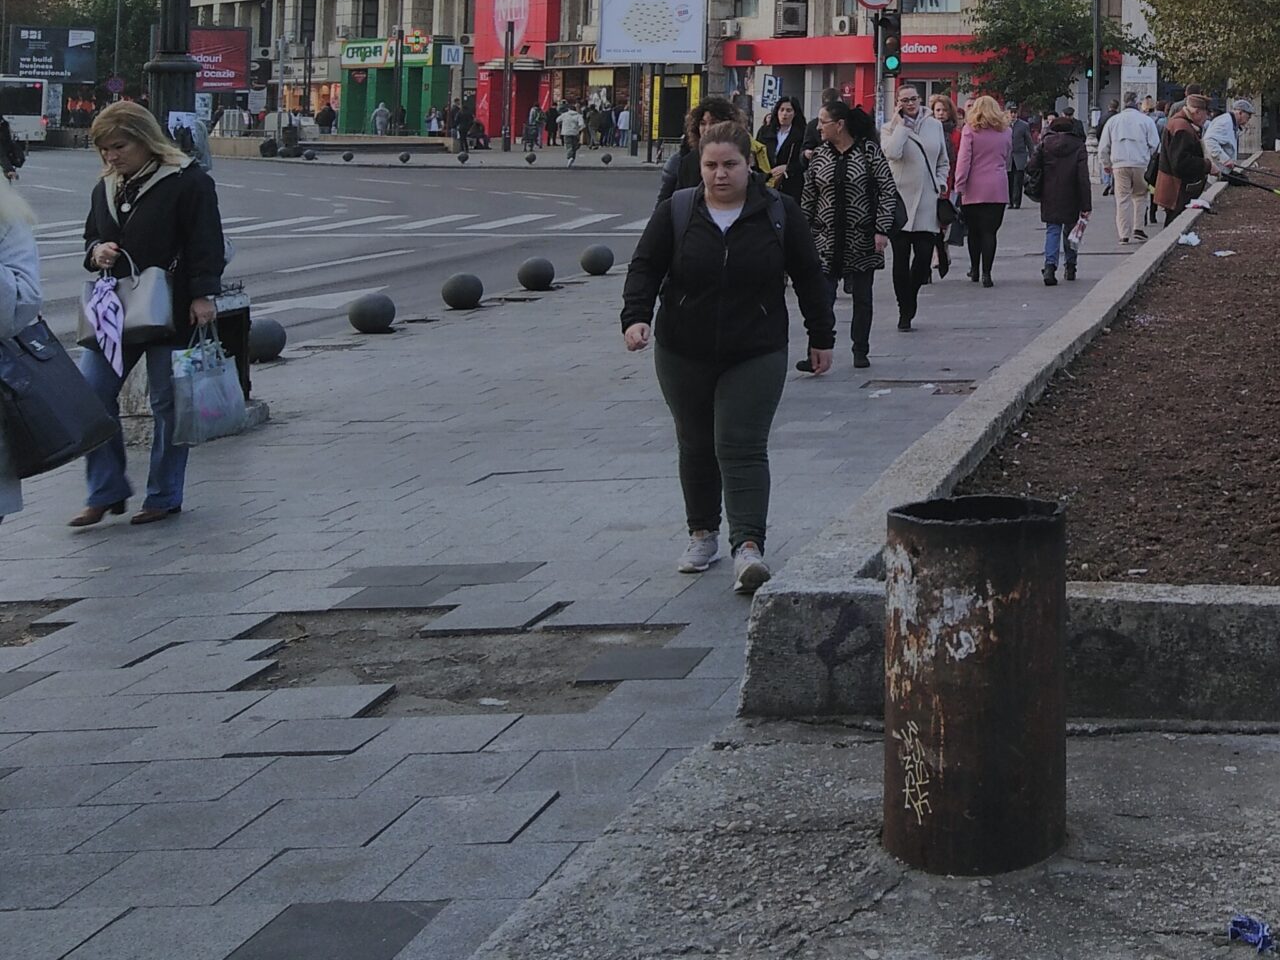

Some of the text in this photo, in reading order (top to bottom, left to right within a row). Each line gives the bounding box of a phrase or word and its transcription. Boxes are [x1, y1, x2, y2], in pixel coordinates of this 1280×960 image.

[32, 55, 53, 63] build
[446, 49, 461, 62] M
[19, 62, 54, 70] business
[19, 69, 72, 77] professionals
[203, 69, 235, 78] ocazie
